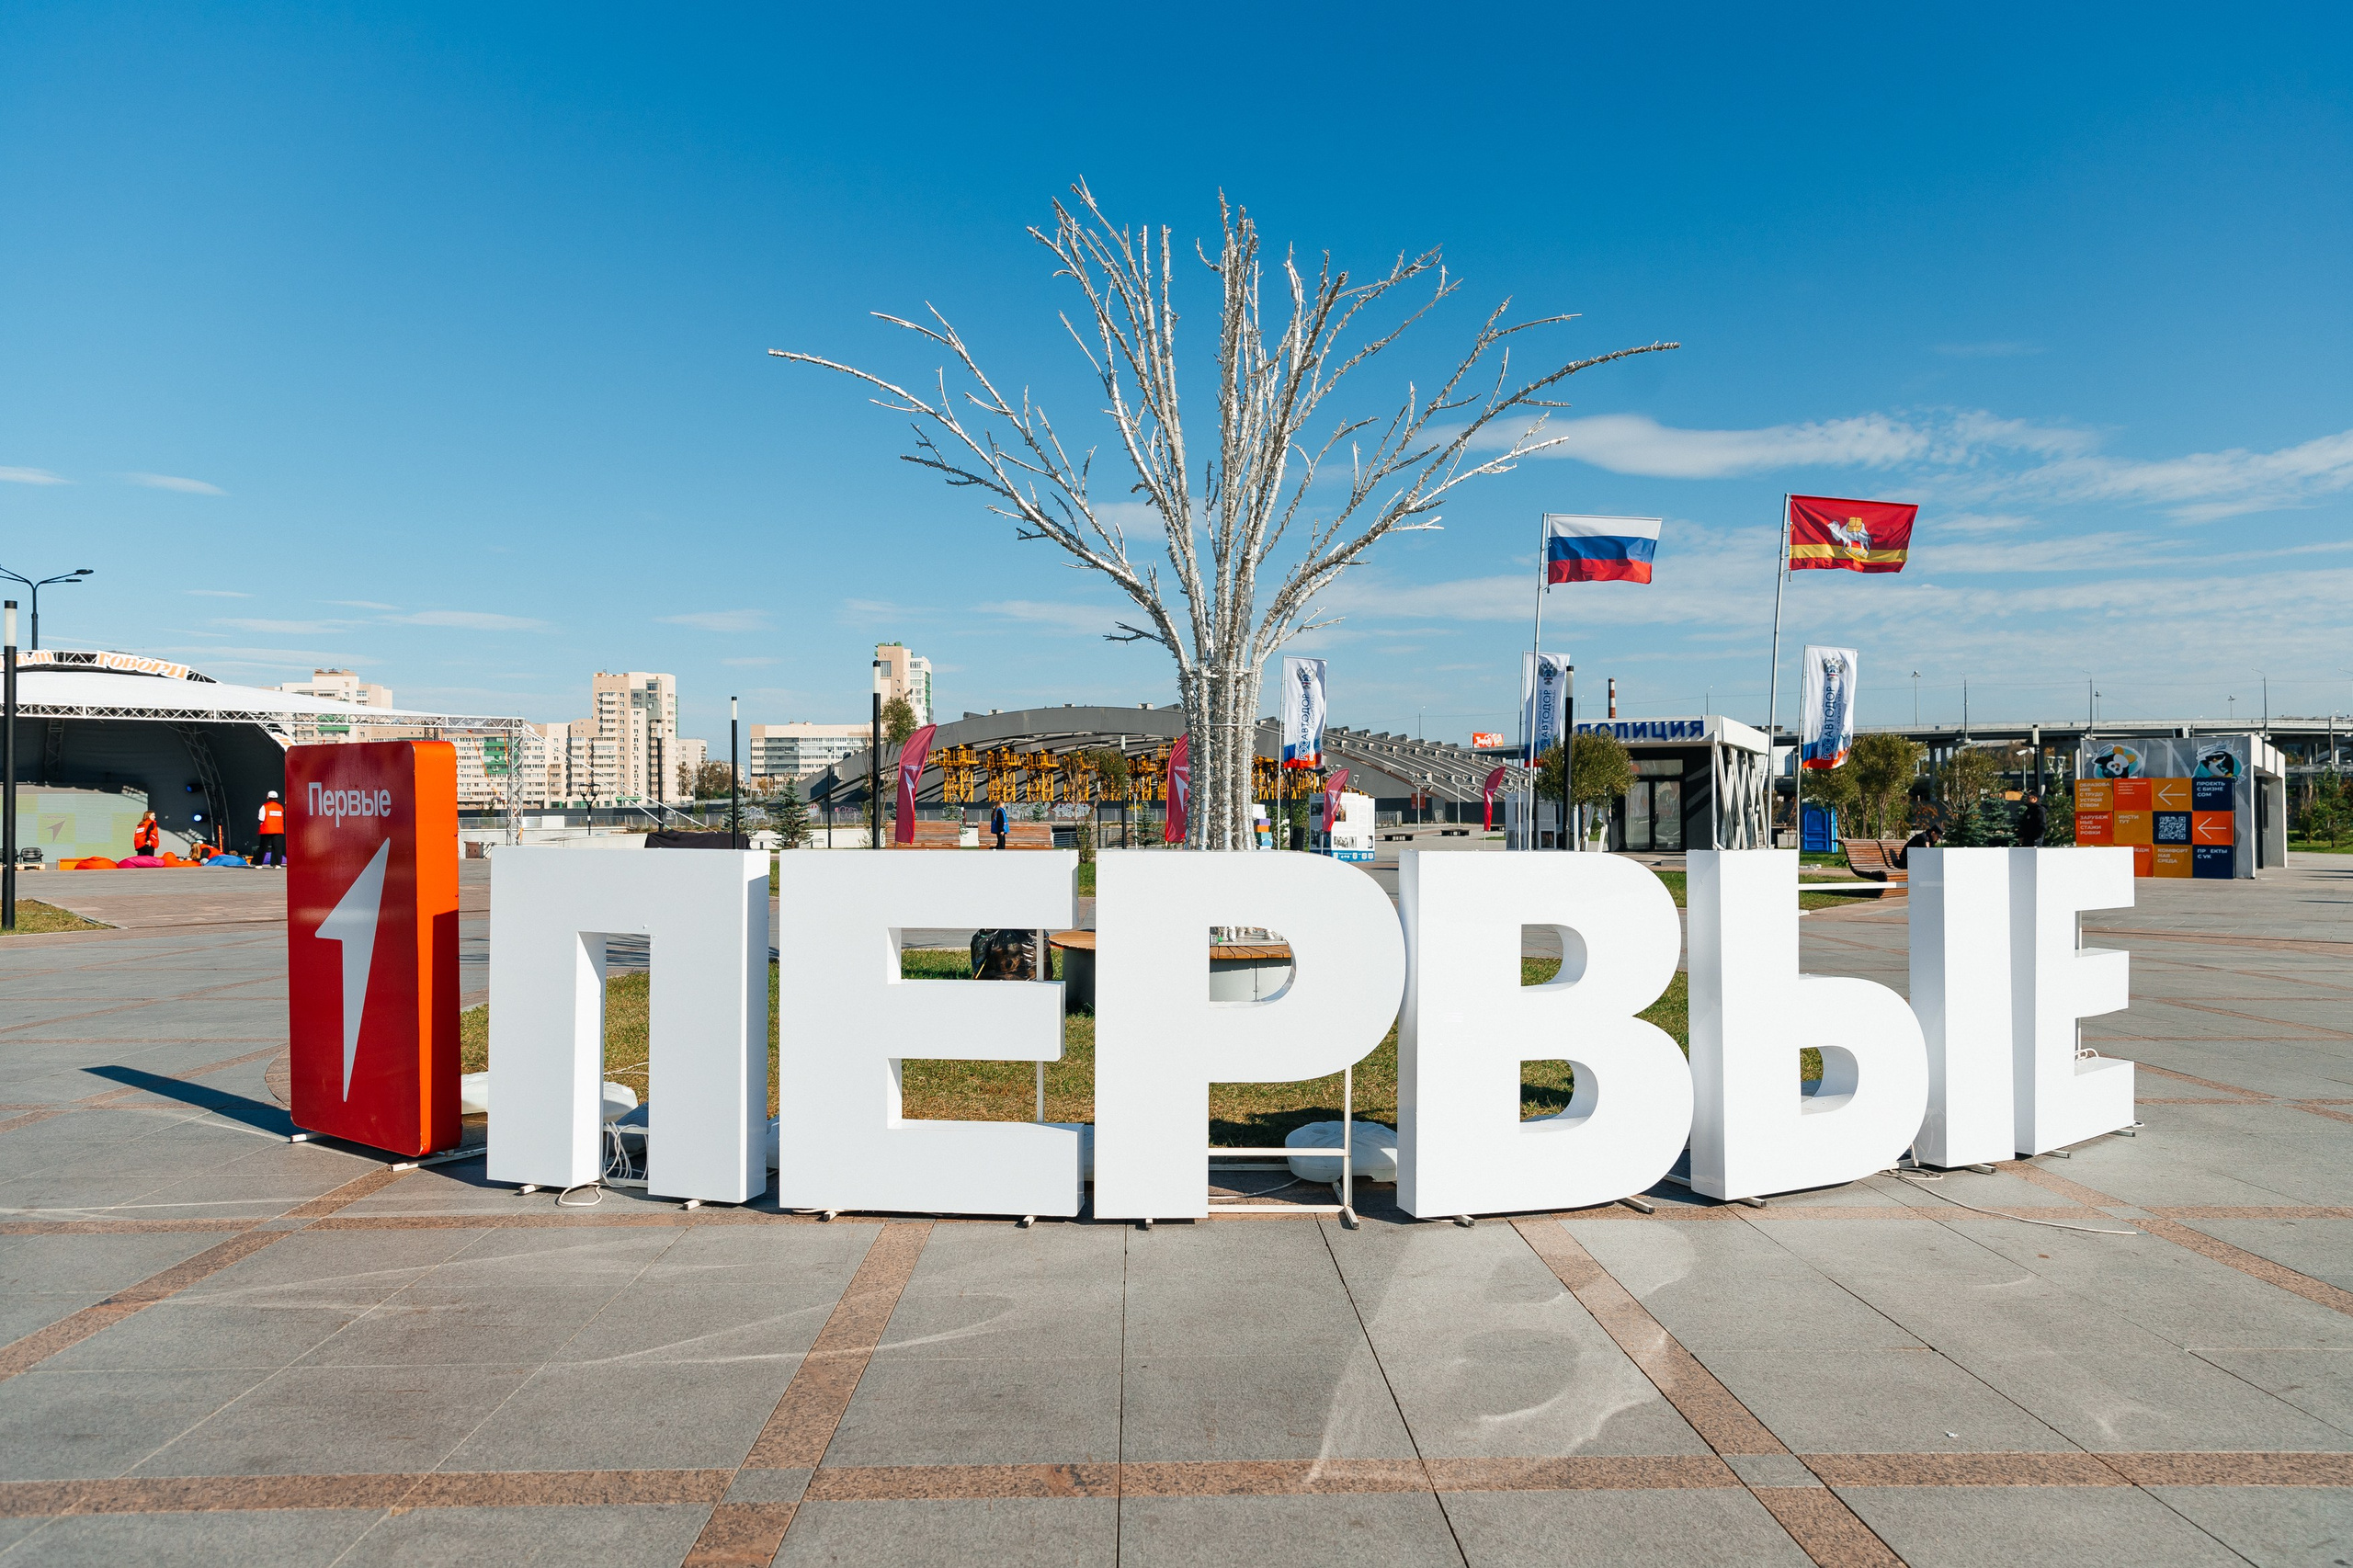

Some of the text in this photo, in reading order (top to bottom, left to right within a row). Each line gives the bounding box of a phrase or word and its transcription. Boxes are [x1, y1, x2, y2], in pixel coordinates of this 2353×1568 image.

[97, 653, 188, 678] ГОВОРИ
[1299, 693, 1310, 761] РОСАВТОДОР
[1540, 689, 1552, 753] ОСАВТОДОР
[1577, 720, 1704, 741] ПОЛИЦИЯ
[1822, 687, 1836, 759] РОСАВТОДОР
[308, 782, 392, 827] Первые
[487, 846, 2135, 1220] ПЕРВЫЕ
